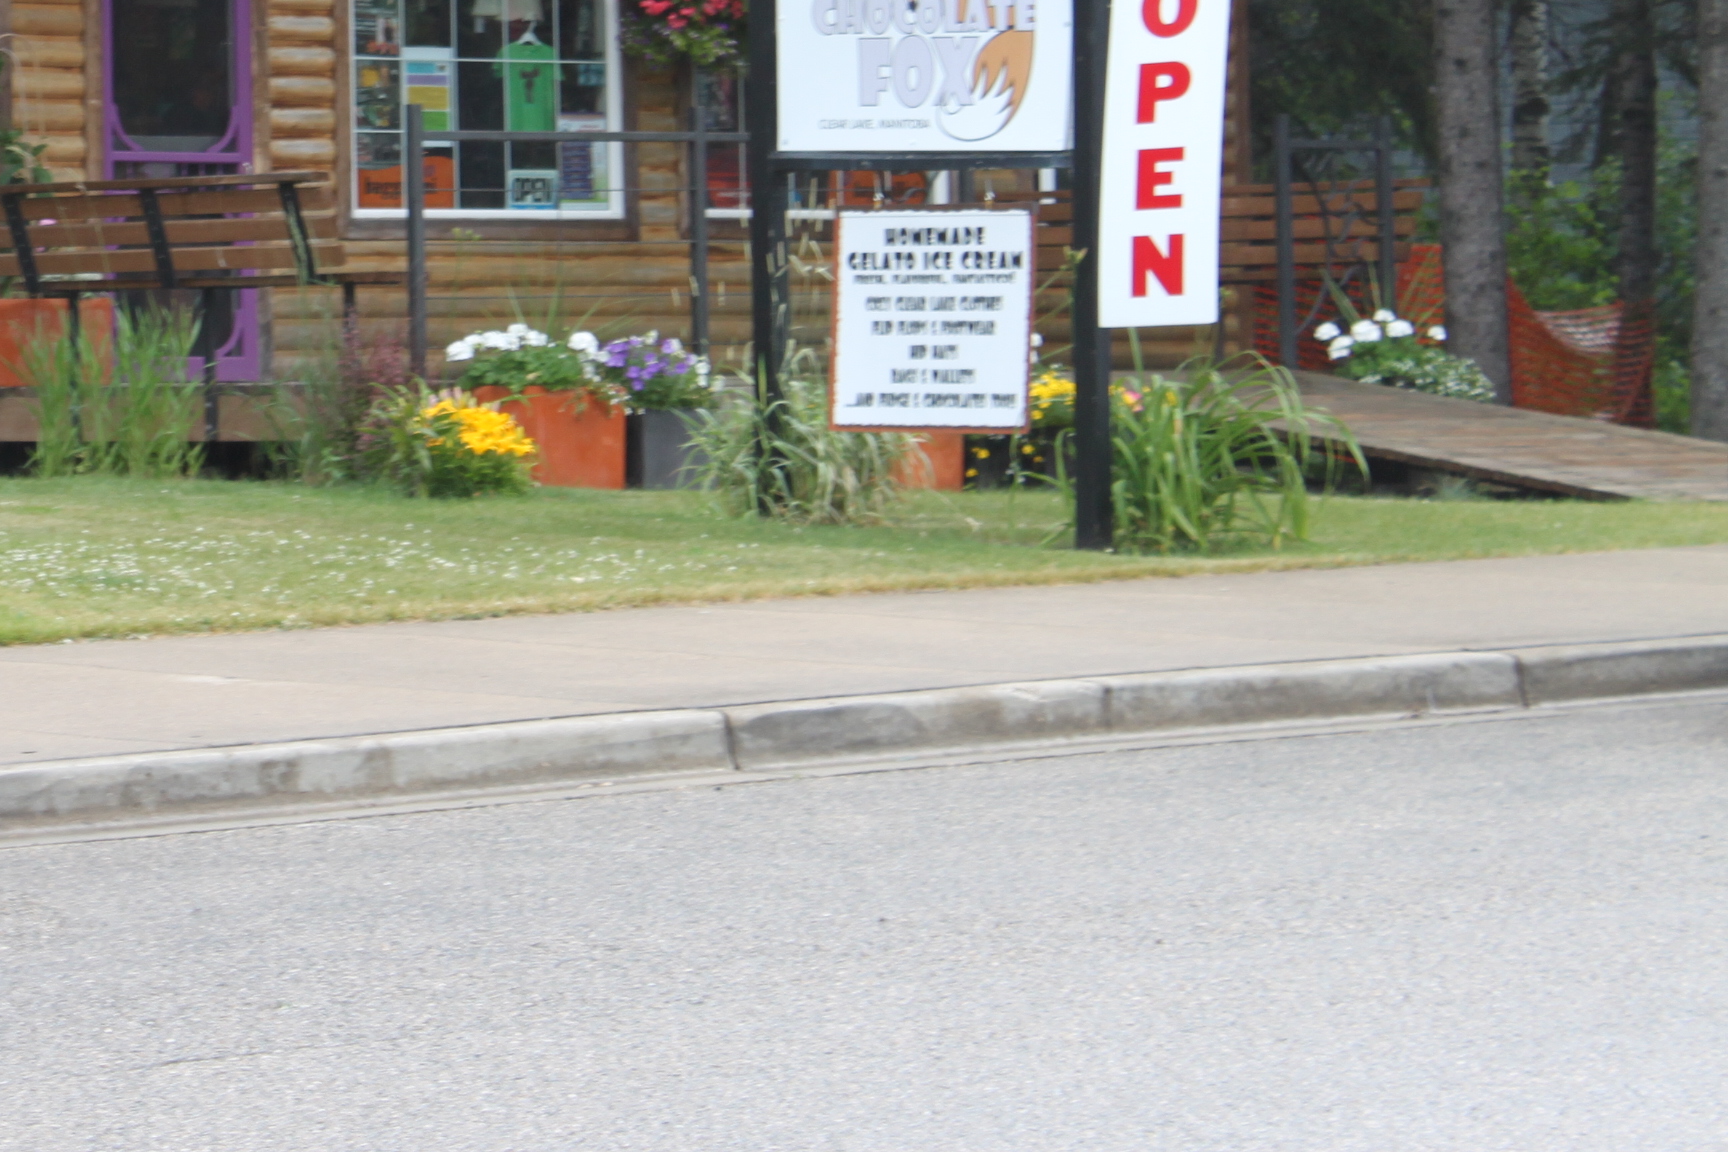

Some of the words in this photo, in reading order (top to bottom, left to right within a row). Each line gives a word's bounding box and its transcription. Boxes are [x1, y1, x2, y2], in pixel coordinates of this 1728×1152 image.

[857, 35, 980, 108] FOX
[884, 227, 985, 246] HOMEMADE
[848, 252, 916, 270] GELATO
[924, 252, 953, 270] ICE
[961, 251, 1023, 269] CREAM
